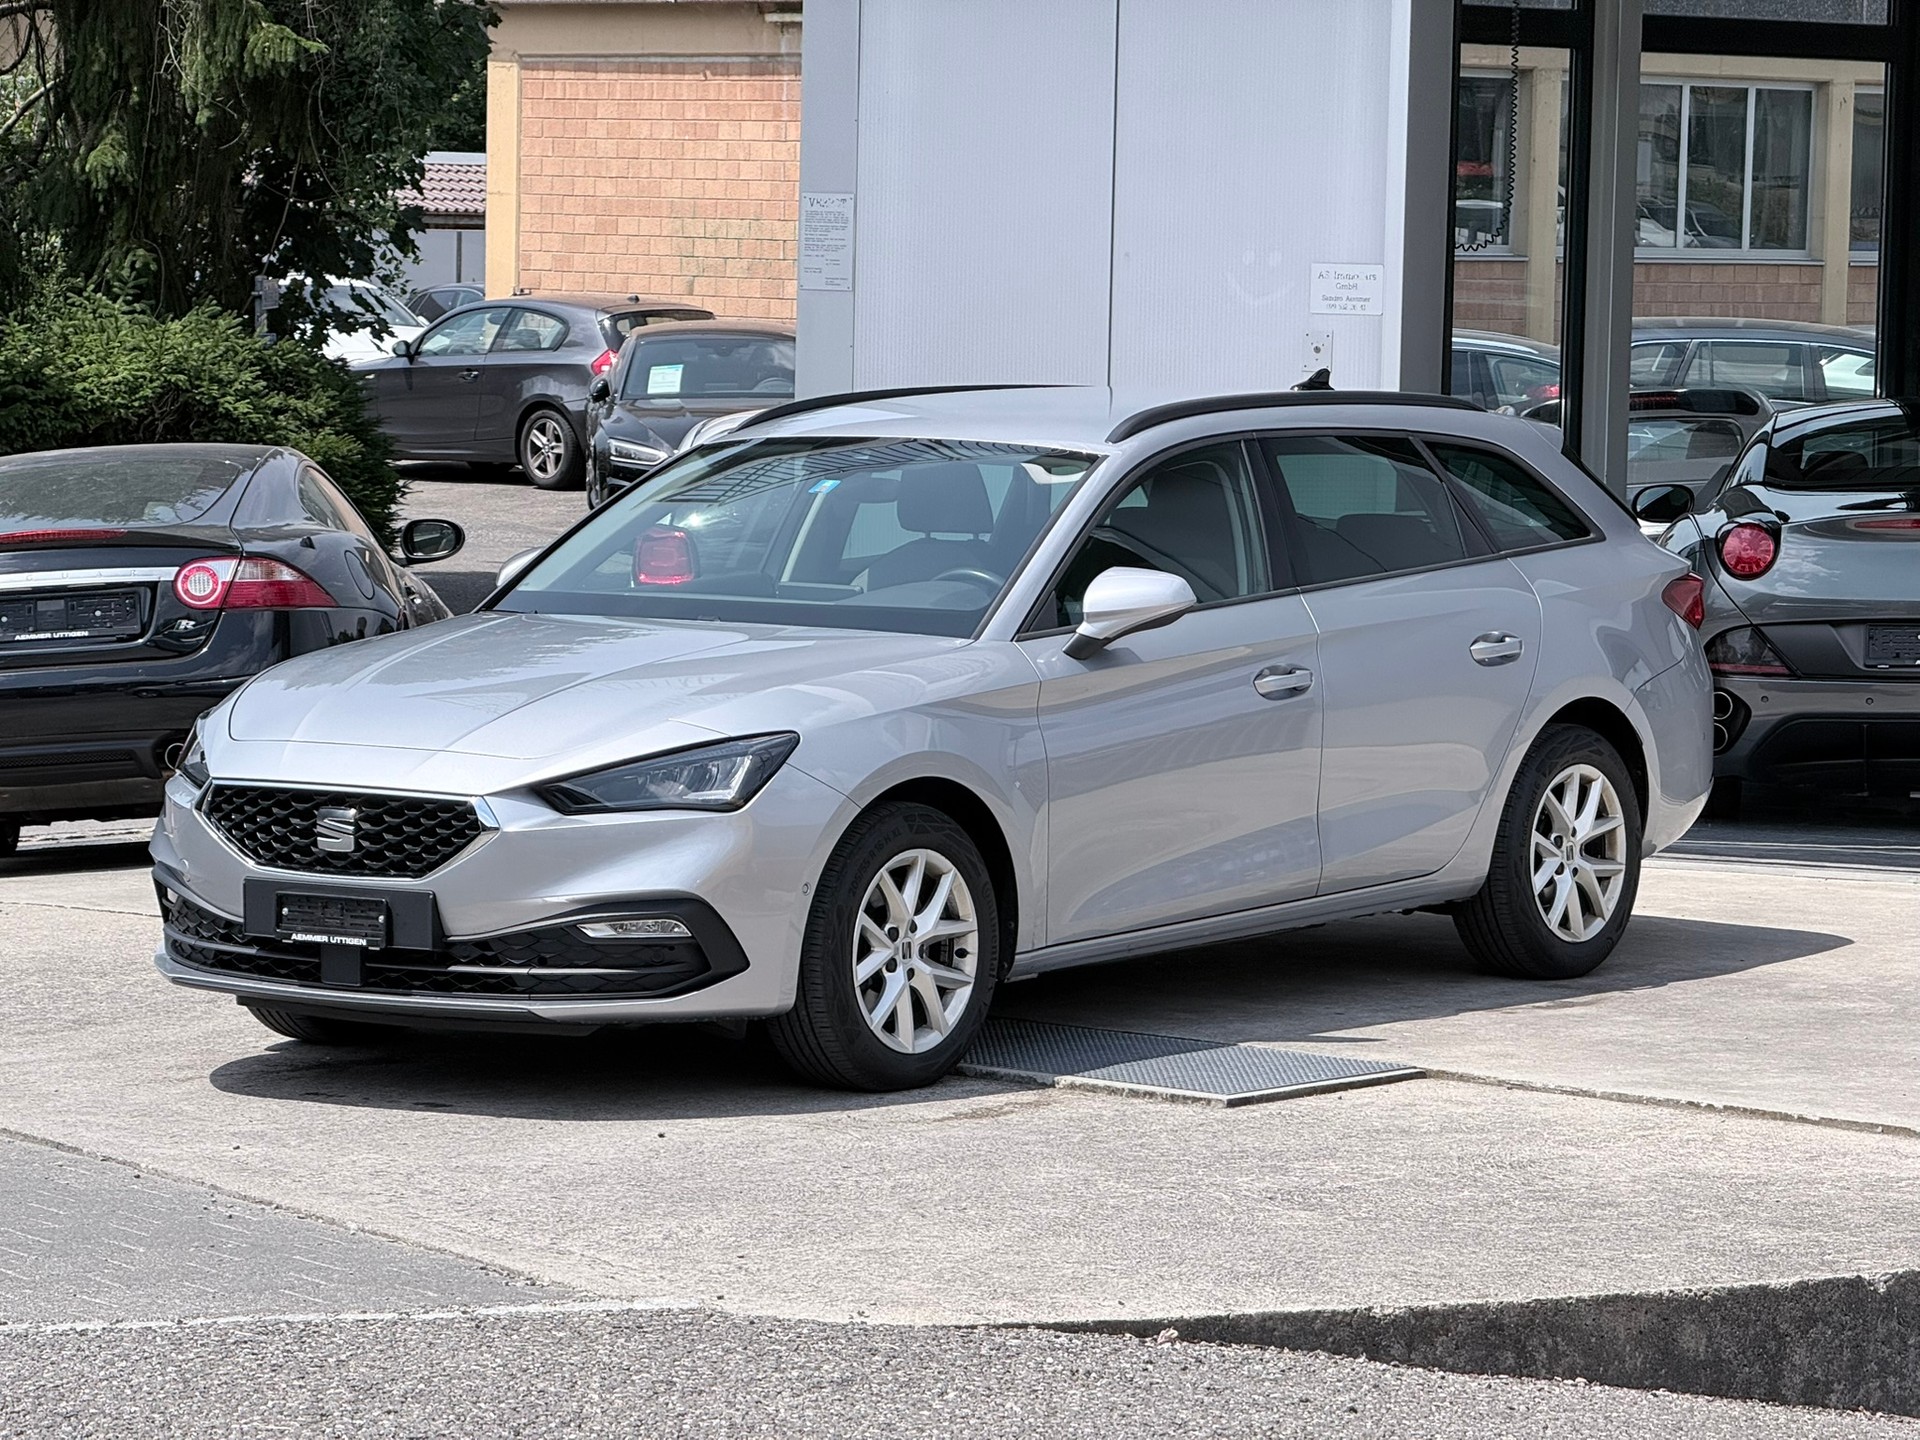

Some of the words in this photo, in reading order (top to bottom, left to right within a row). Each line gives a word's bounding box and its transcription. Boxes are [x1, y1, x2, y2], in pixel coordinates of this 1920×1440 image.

[1335, 282, 1358, 290] GmbH
[14, 632, 52, 641] AEMMER
[53, 631, 89, 639] UTTIGEN
[290, 932, 329, 942] AEMMER
[330, 936, 367, 946] UTTIGEN
